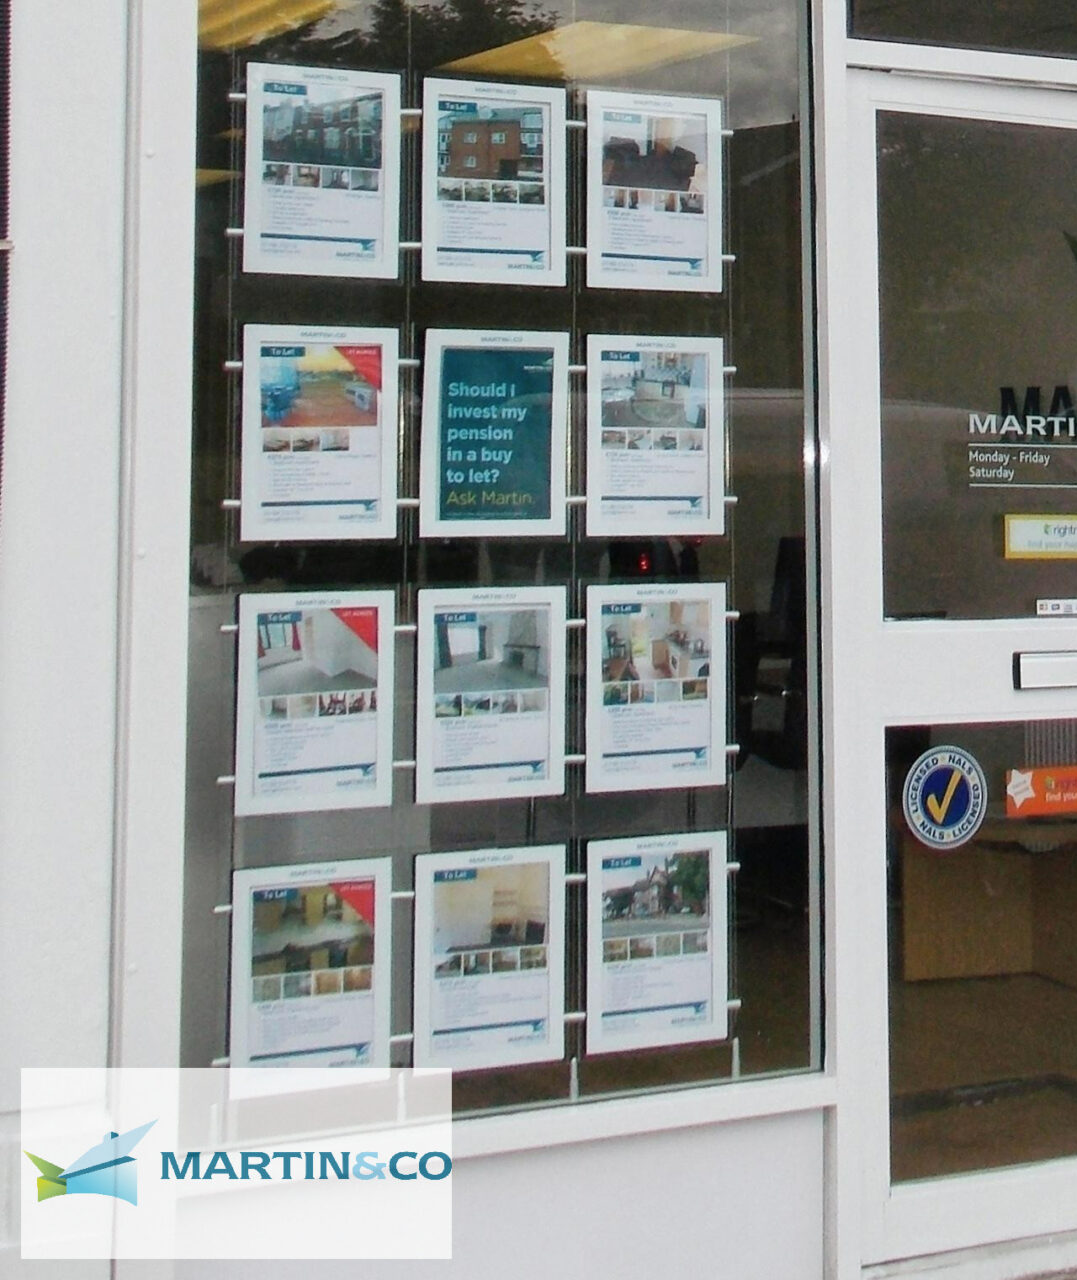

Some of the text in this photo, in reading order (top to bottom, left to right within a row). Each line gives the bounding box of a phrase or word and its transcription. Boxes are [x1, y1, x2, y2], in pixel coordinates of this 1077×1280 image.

[447, 382, 507, 397] Should
[447, 403, 528, 421] invest my
[447, 425, 514, 442] pension
[446, 446, 513, 465] in a buy
[968, 451, 1010, 465] Monday
[1019, 451, 1051, 468] Friday
[446, 468, 500, 483] to let?
[968, 466, 1015, 482] Saturday
[446, 490, 477, 505] Ask
[948, 754, 974, 775] NALS
[910, 757, 939, 814] LICENSED
[919, 820, 945, 840] NALS
